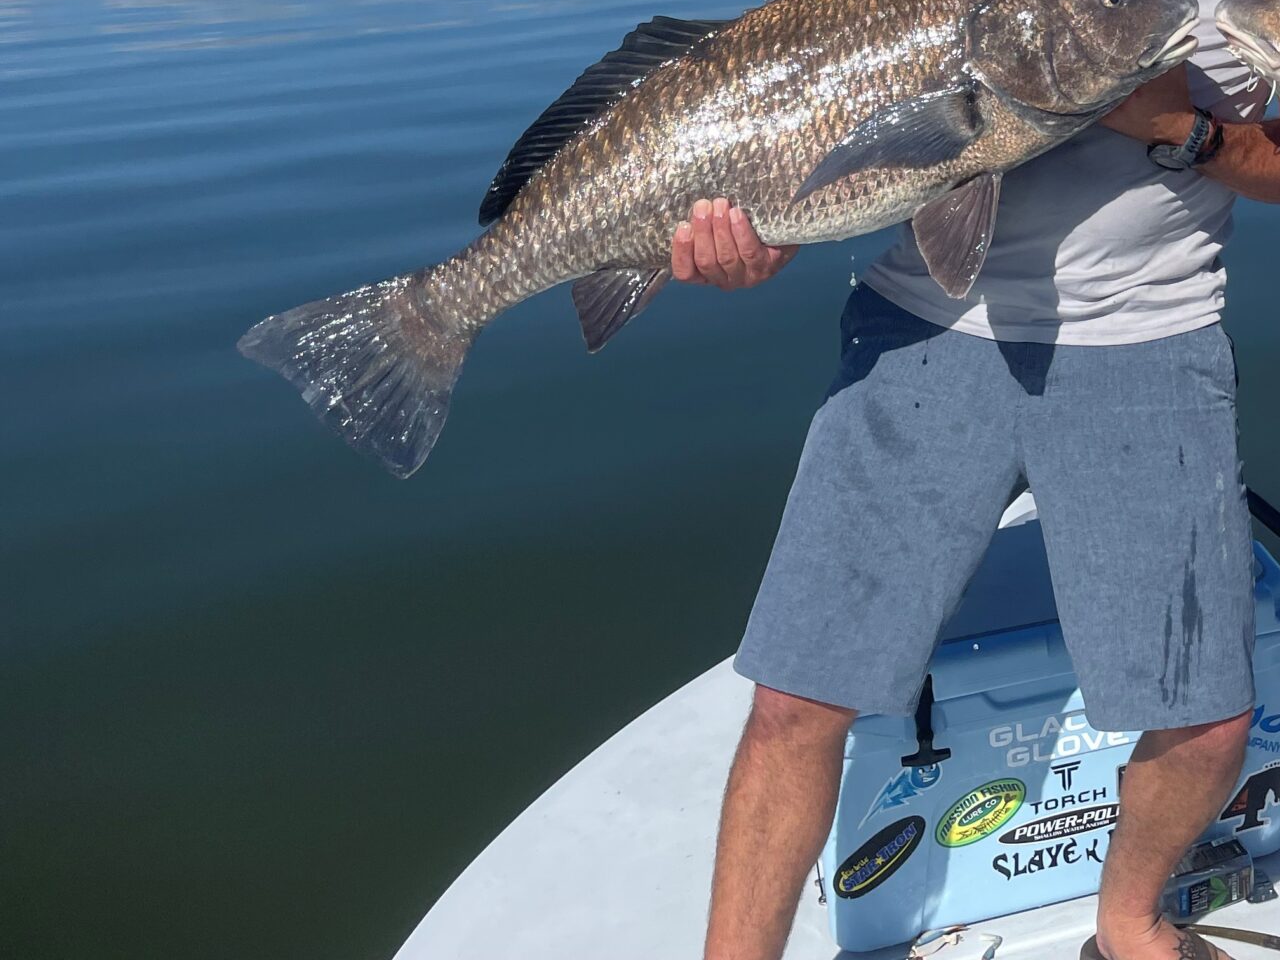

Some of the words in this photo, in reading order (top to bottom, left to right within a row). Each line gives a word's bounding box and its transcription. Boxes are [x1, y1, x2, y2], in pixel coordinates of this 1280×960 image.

[989, 716, 1087, 748] GLAC
[1006, 731, 1130, 768] GLOVE
[941, 793, 979, 841] MISSION
[980, 783, 1022, 798] FISHIN
[962, 807, 983, 824] LURE
[985, 798, 997, 809] CO
[1030, 787, 1106, 815] TORCH
[843, 859, 877, 891] STAR
[875, 823, 917, 860] TRON
[1191, 886, 1200, 913] PURE
[1199, 882, 1208, 910] LEAF
